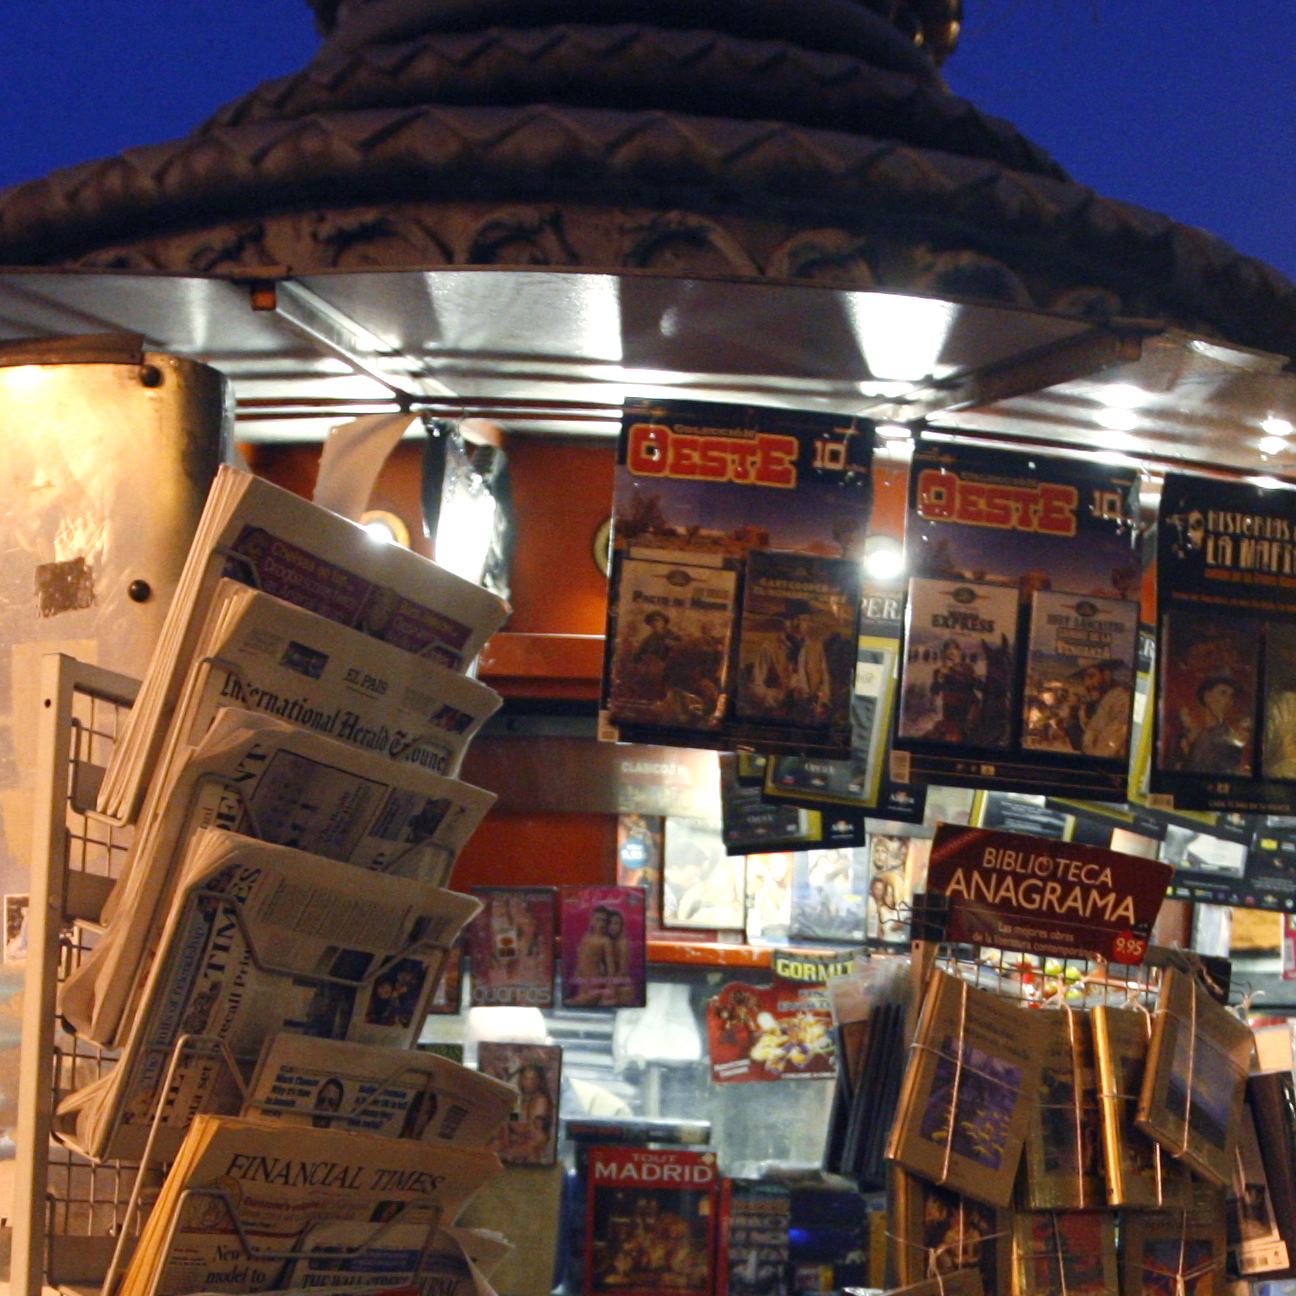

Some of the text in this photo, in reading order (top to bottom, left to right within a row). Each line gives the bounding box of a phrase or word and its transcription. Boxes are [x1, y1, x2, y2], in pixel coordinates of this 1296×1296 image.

[628, 423, 798, 489] OESTE
[813, 440, 847, 470] 10
[917, 468, 1078, 537] OESTE
[1205, 534, 1234, 567] LA
[932, 614, 995, 634] EXPRESS
[343, 668, 361, 683] EL
[340, 712, 388, 751] Herald
[982, 847, 1113, 888] BIBLIOTECA
[945, 867, 1136, 925] ANAGRAMA
[204, 867, 262, 980] TIMES
[1014, 924, 1048, 939] mejores
[1050, 930, 1075, 942] obras
[595, 1161, 714, 1183] MADRID
[632, 1152, 678, 1163] TOUT
[224, 1152, 446, 1195] FINANCIAL TIMES
[212, 1245, 241, 1263] New
[206, 1264, 267, 1284] model to
